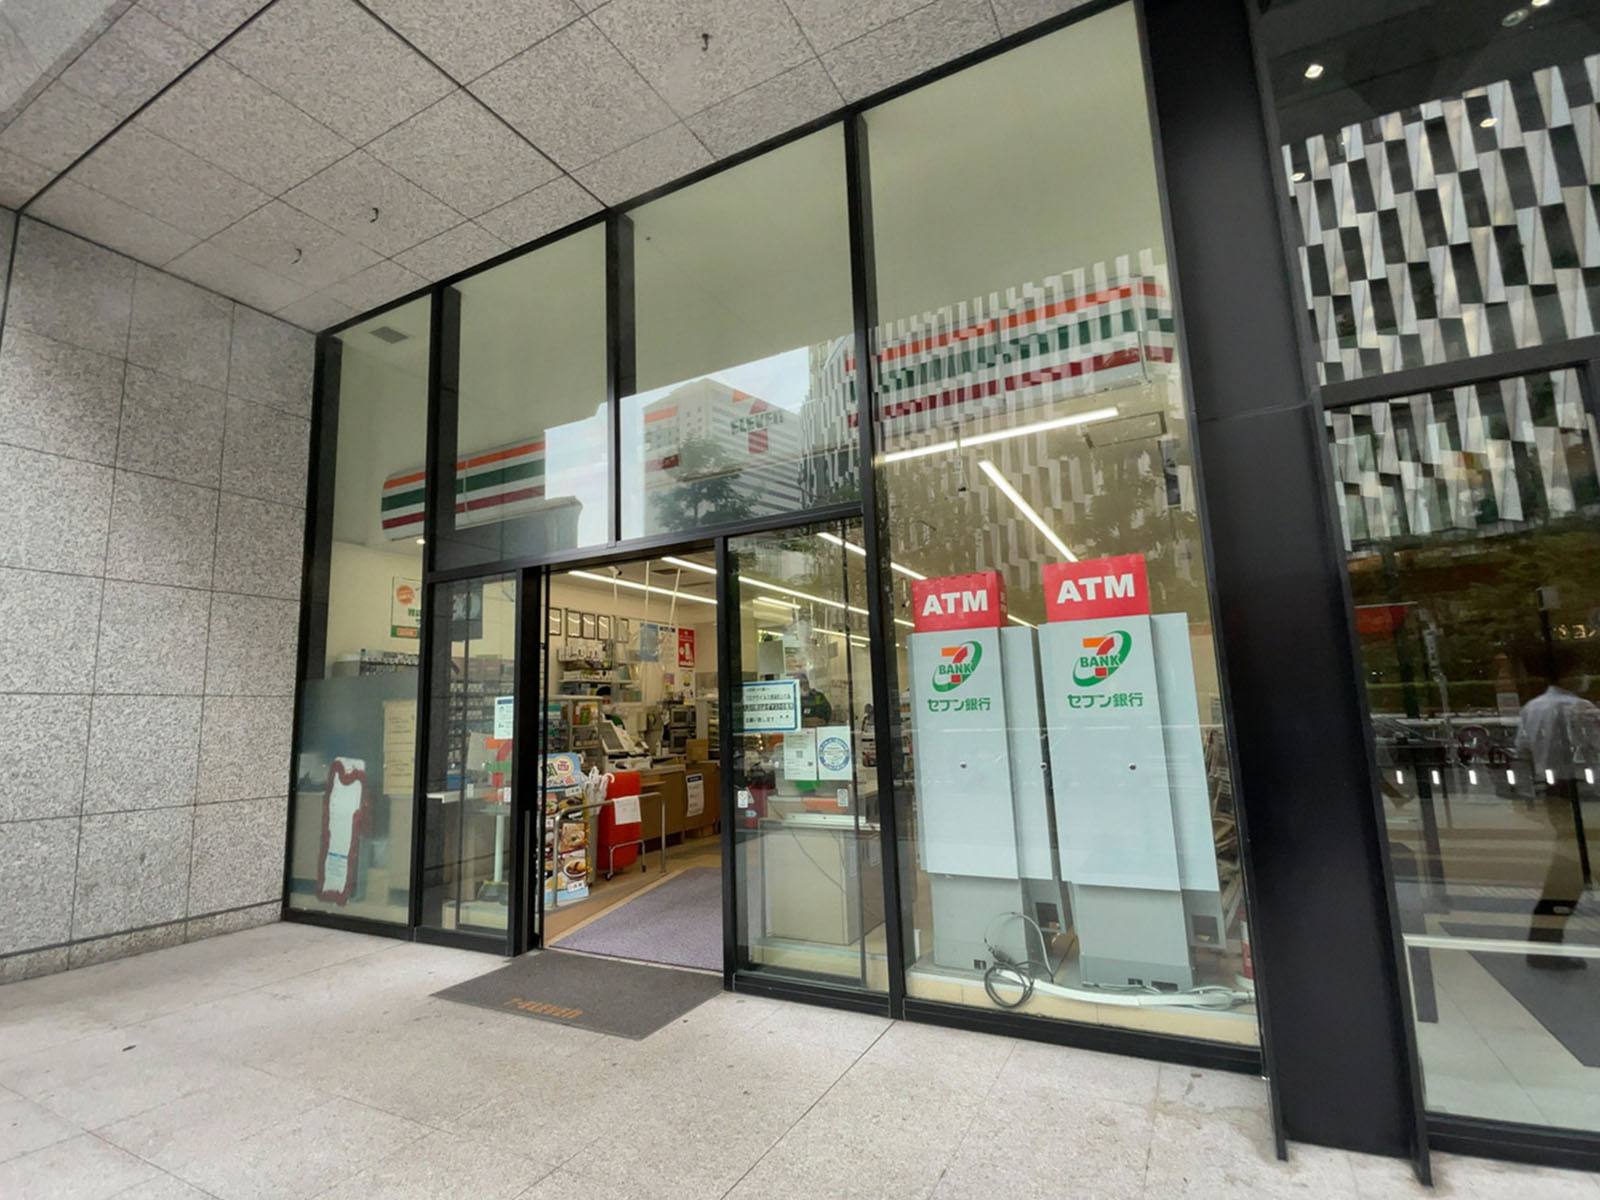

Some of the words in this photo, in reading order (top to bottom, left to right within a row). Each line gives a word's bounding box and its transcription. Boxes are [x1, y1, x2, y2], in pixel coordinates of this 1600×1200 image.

[1057, 573, 1136, 604] ATM
[922, 589, 988, 616] ATM
[1080, 654, 1120, 668] BANK
[938, 663, 973, 676] BANK
[928, 697, 991, 713] セブン銀行
[1067, 692, 1143, 709] セブン銀行
